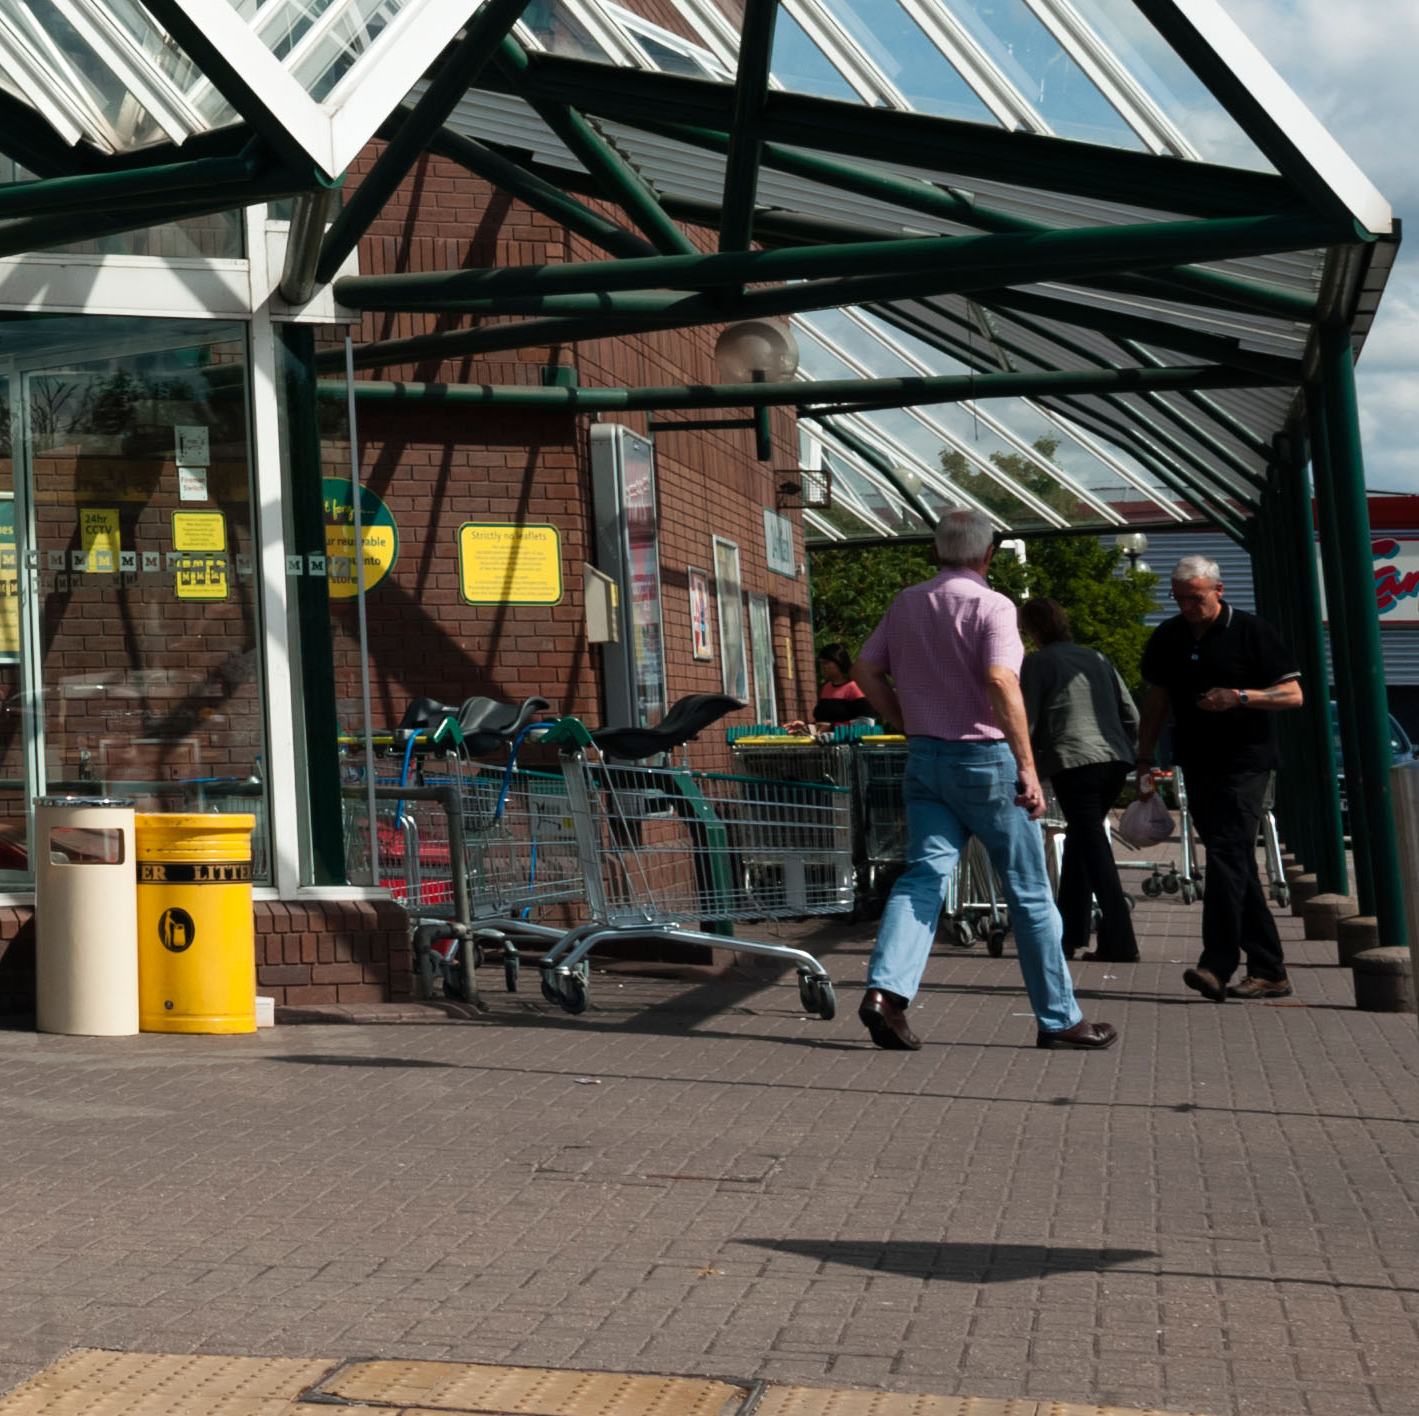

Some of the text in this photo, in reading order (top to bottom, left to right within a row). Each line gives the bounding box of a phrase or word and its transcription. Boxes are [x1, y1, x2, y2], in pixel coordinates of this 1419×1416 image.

[85, 514, 108, 523] 24hr
[86, 525, 112, 535] CCTV
[471, 531, 502, 542] Strictly
